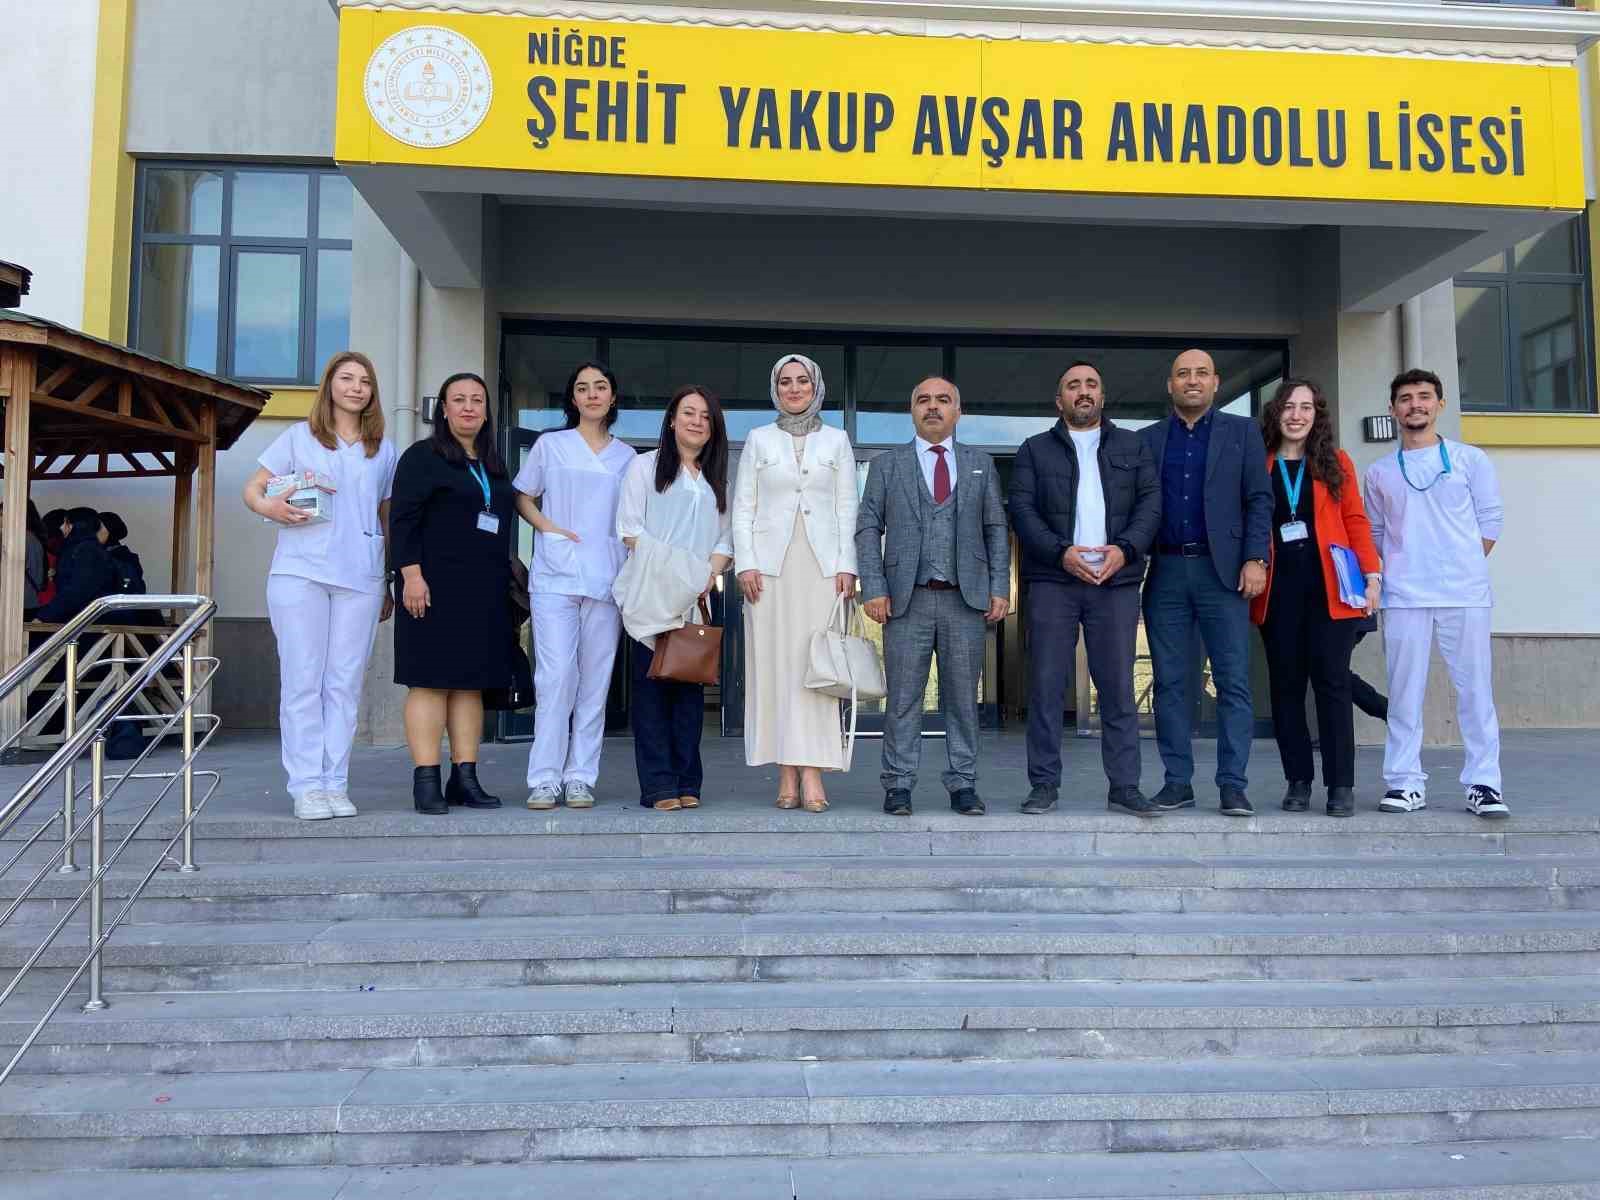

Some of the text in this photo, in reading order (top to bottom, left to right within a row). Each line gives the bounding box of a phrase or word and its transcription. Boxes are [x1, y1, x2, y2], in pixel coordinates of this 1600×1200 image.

[528, 27, 626, 69] NİĞDE
[526, 69, 687, 149] ŞEHİT
[718, 86, 895, 153] YAKUP
[911, 95, 1083, 168] AVŞAR
[1106, 102, 1347, 168] ANADOLU
[1367, 101, 1525, 177] LİSESİ
